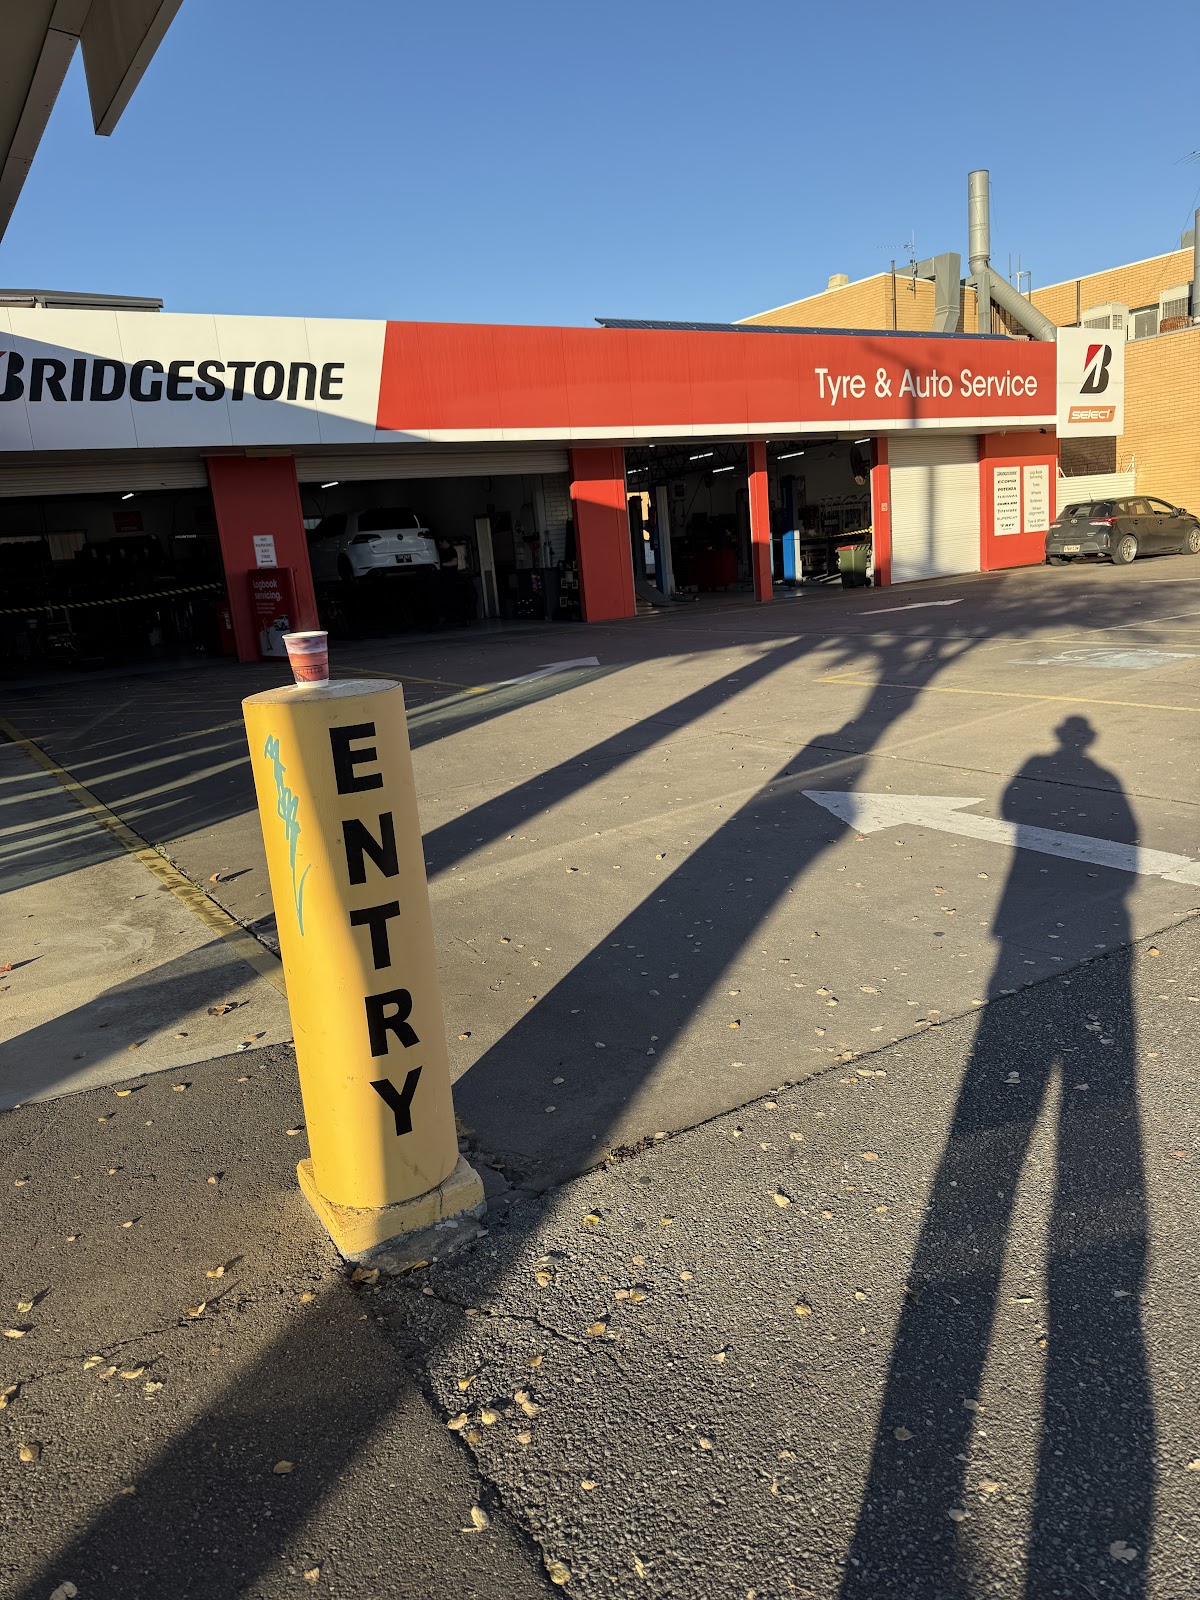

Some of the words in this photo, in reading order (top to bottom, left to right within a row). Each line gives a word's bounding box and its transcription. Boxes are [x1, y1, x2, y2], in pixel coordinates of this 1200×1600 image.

[0, 351, 345, 402] BRIDGESTONE
[814, 368, 866, 406] Tyre
[874, 367, 892, 399] &
[898, 368, 953, 398] Auto
[960, 368, 1038, 398] Service
[329, 722, 422, 1136] ENTRY
